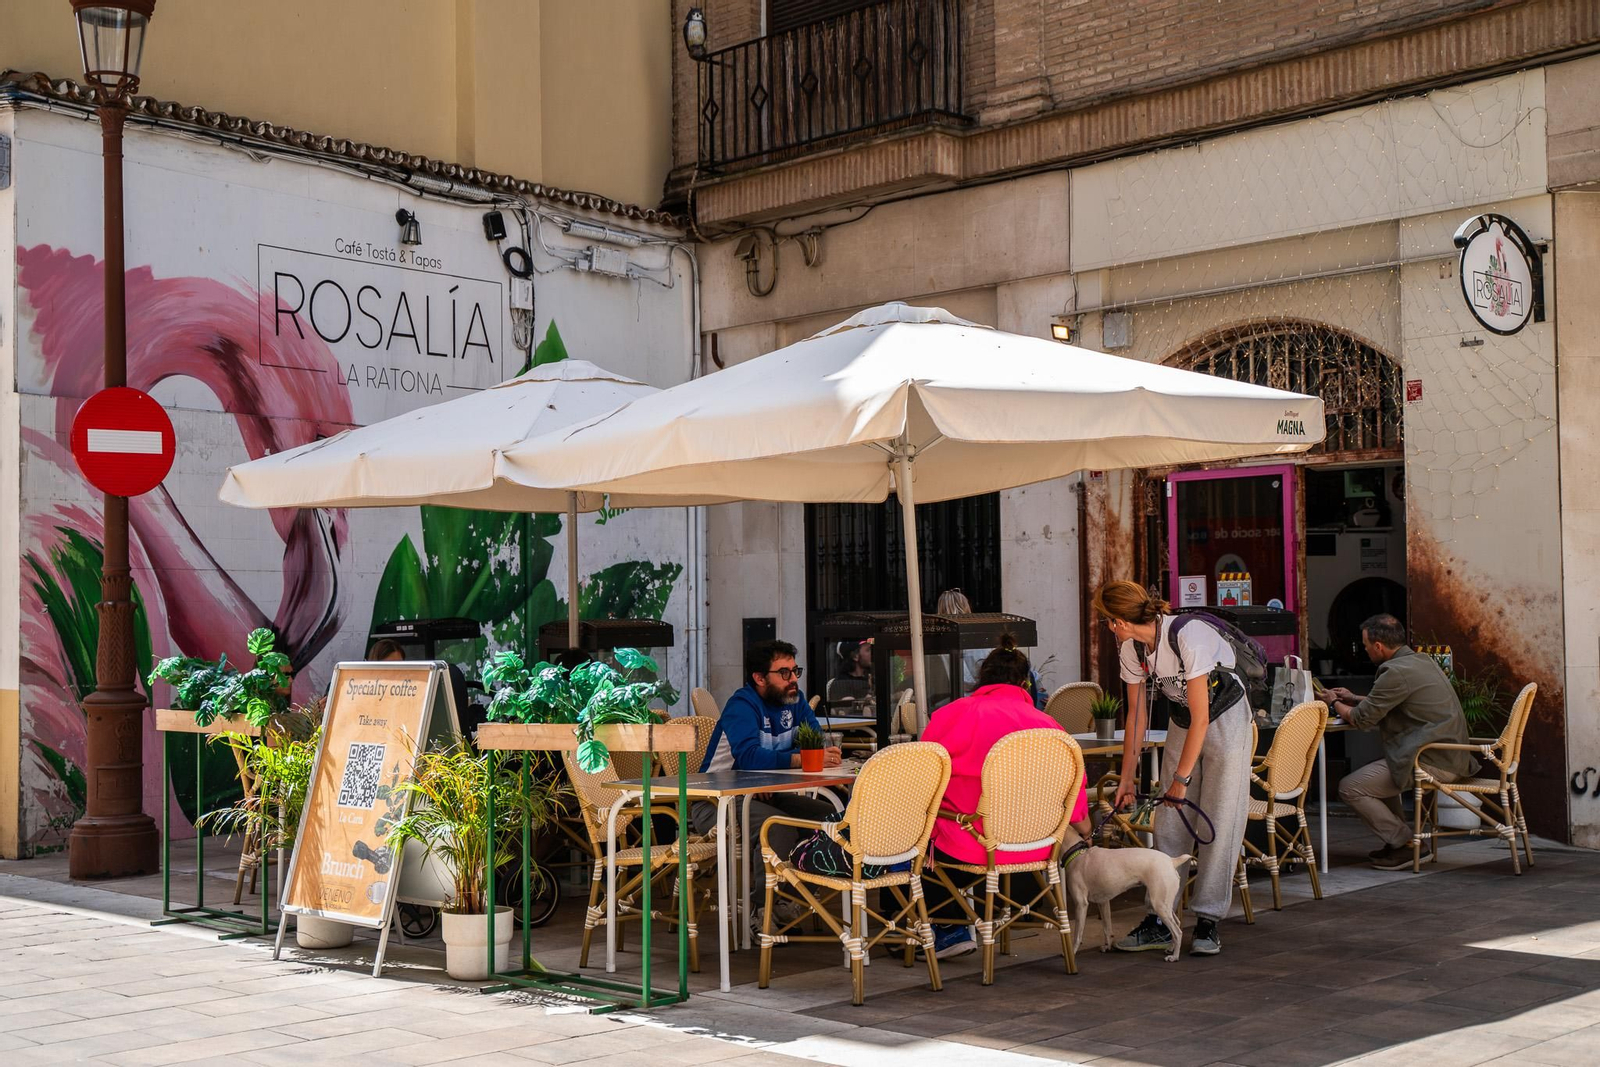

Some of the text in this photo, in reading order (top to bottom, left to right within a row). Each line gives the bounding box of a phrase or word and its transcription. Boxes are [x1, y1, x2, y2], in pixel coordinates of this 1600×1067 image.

[335, 238, 442, 270] Café Tostá & Tapas
[275, 271, 494, 363] ROSALÍA
[337, 362, 443, 395] LA RATONA
[1277, 419, 1306, 435] MAGNA
[347, 677, 417, 701] Specialty coffee
[359, 715, 388, 728] Take away
[321, 852, 364, 880] Brunch
